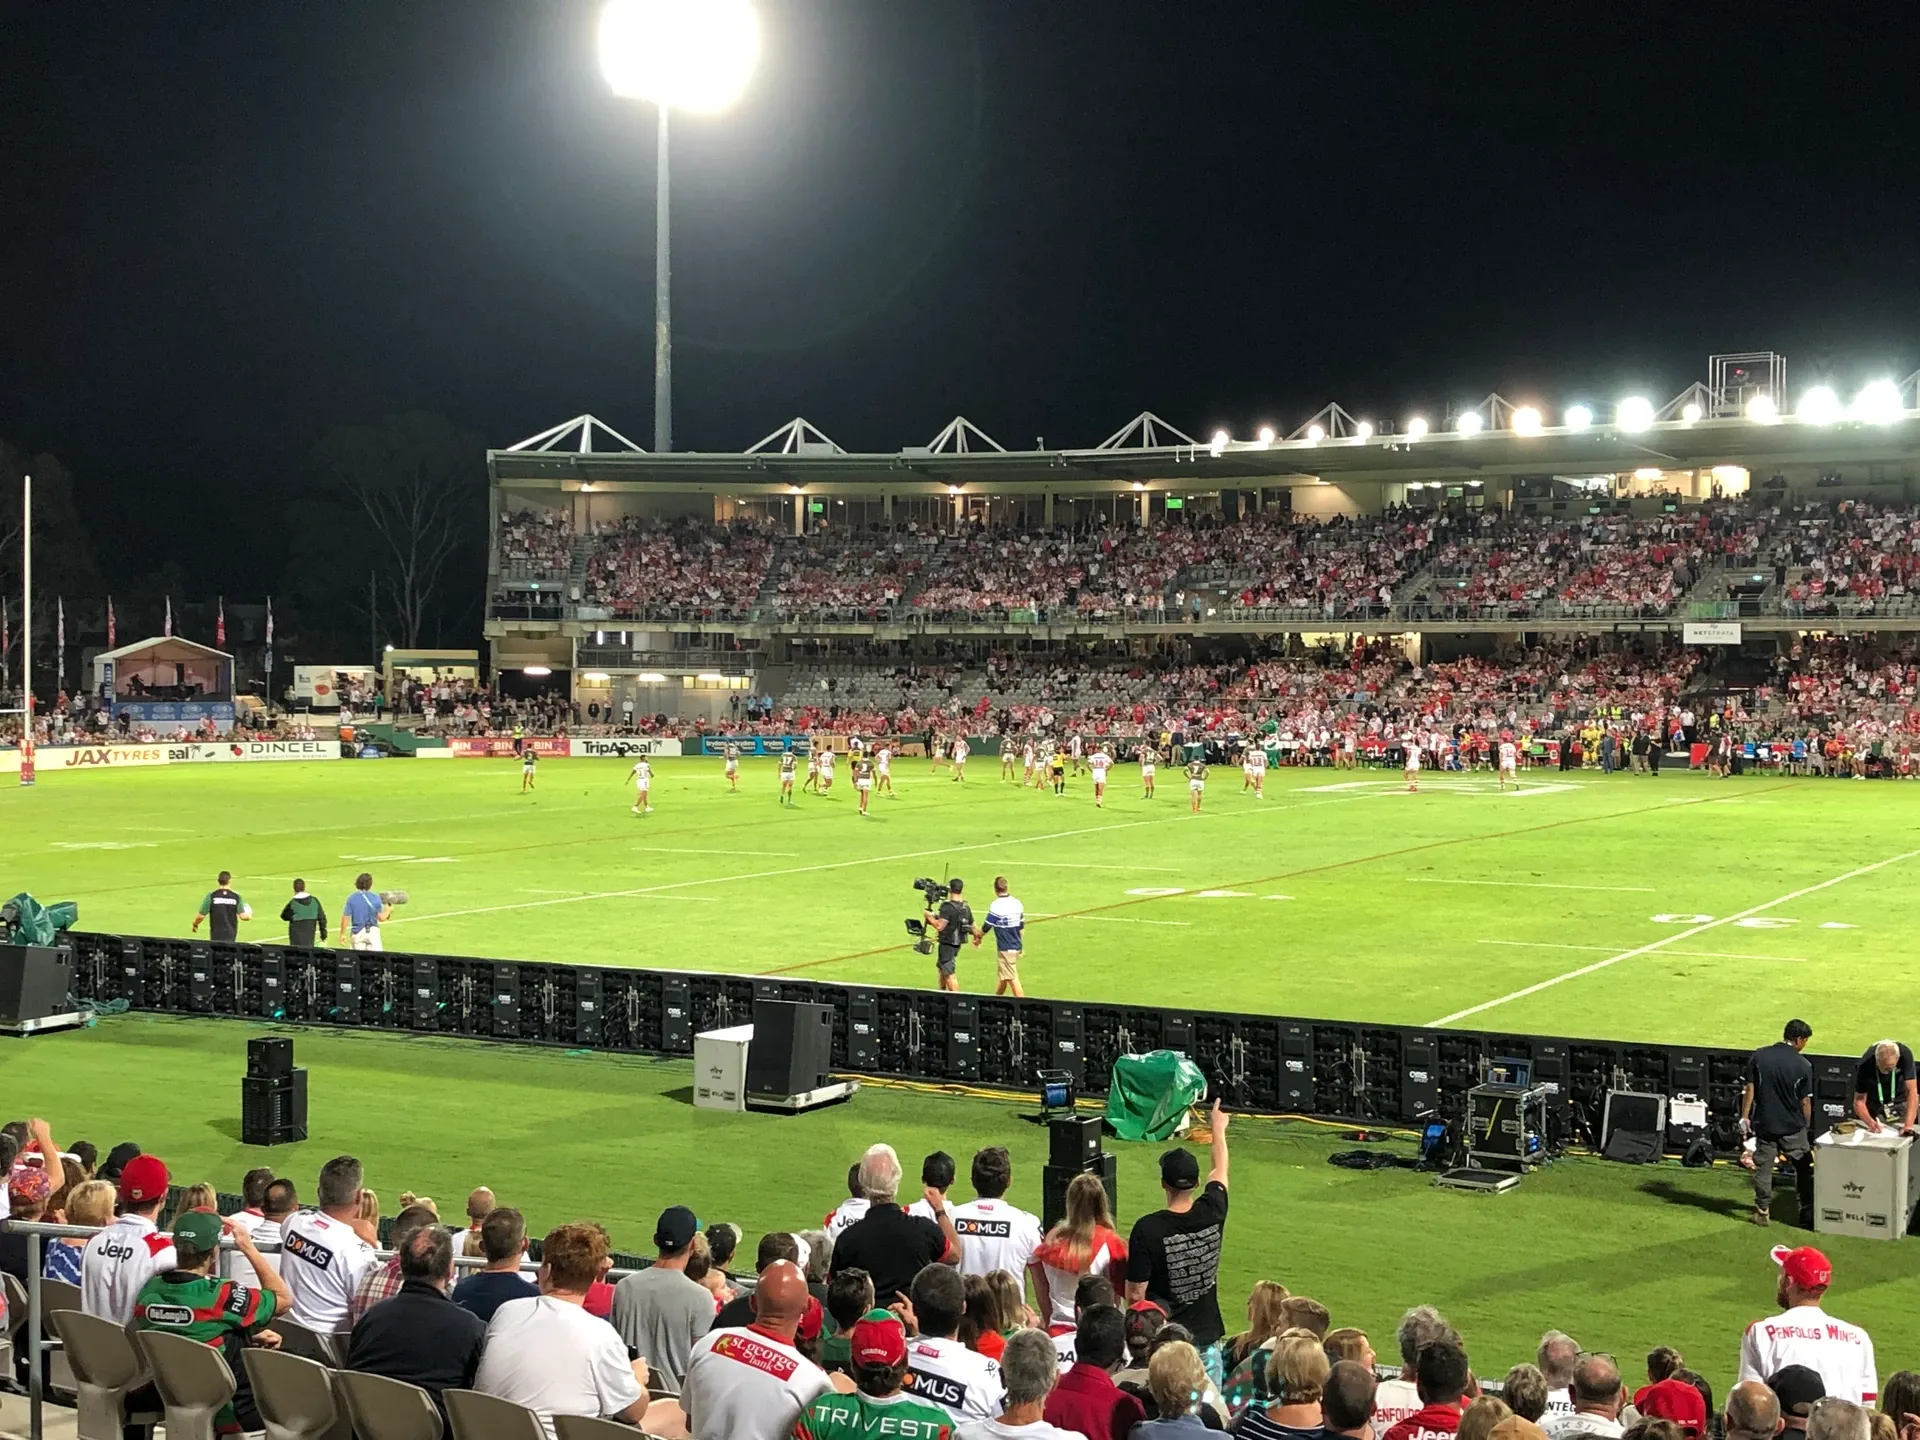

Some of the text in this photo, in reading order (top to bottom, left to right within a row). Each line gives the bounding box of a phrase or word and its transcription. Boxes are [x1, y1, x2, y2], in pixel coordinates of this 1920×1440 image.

[251, 743, 327, 753] DINCEL
[65, 749, 160, 766] JAX TYRES
[957, 1221, 1007, 1234] DOMUS
[97, 1239, 133, 1263] Jeep
[286, 1235, 329, 1265] DOMUS
[749, 1354, 775, 1371] bank
[815, 1405, 939, 1440] TRIVEST
